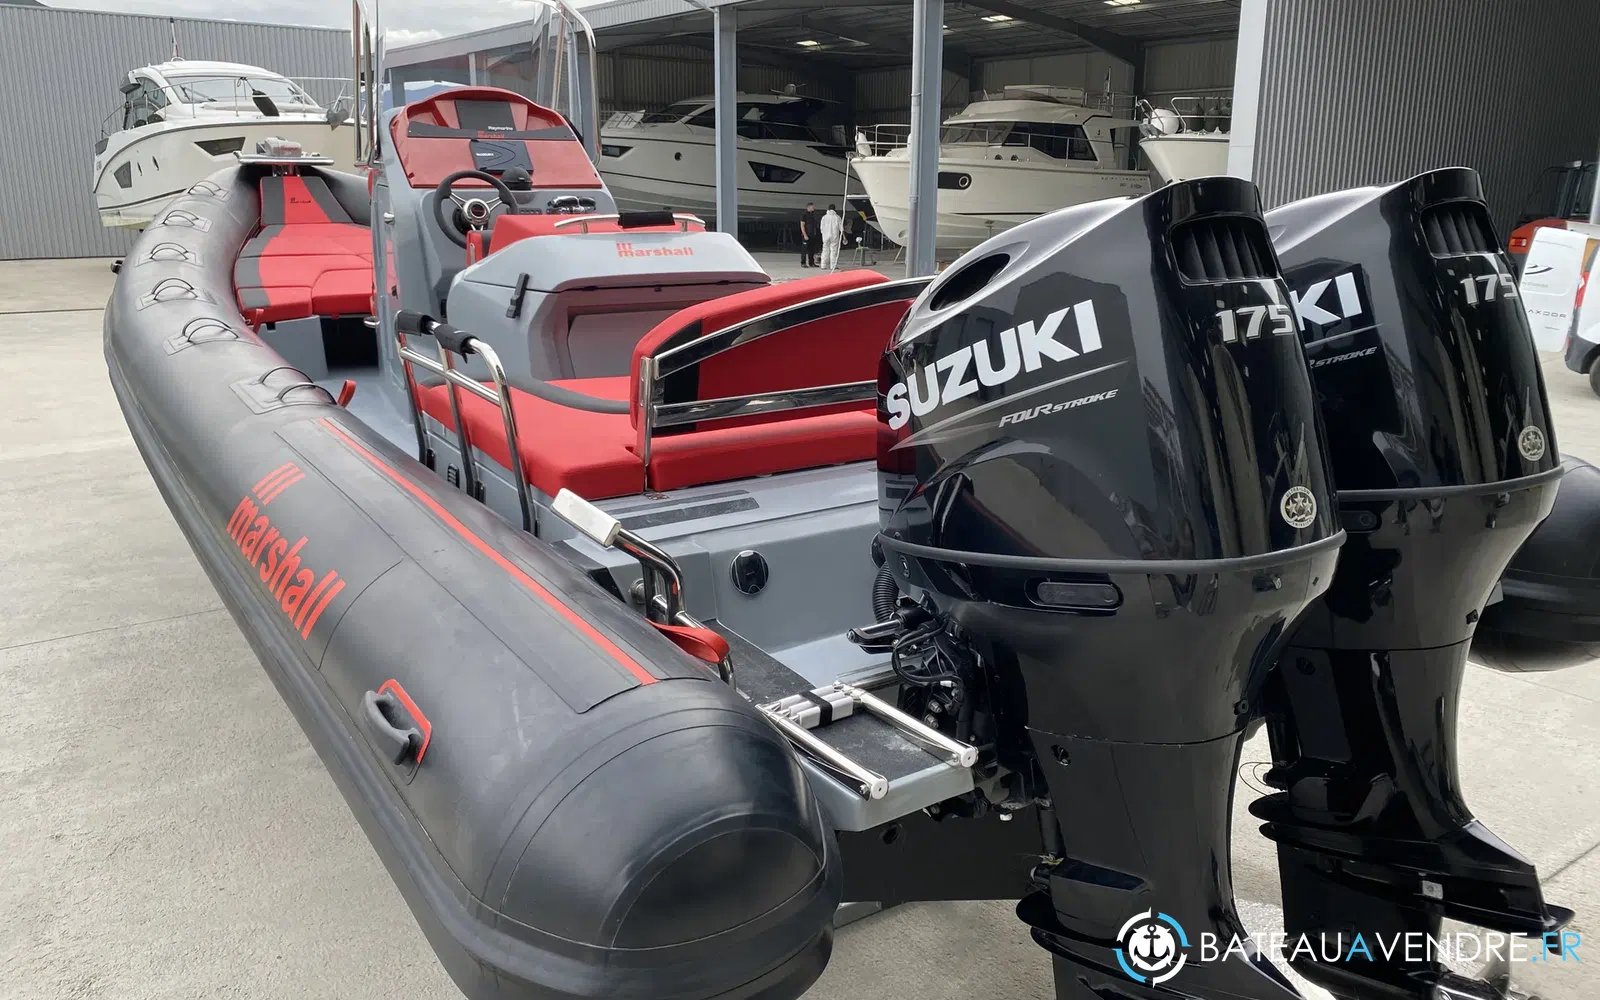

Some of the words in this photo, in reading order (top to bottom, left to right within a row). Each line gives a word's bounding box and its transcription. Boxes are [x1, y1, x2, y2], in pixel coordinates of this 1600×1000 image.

[617, 246, 694, 257] marshall
[1460, 273, 1519, 305] 175
[1215, 304, 1294, 343] 175
[1527, 309, 1567, 319] AXDOR
[886, 299, 1102, 430] SUZUKI
[1309, 346, 1378, 369] STROKE
[225, 495, 346, 641] marshall
